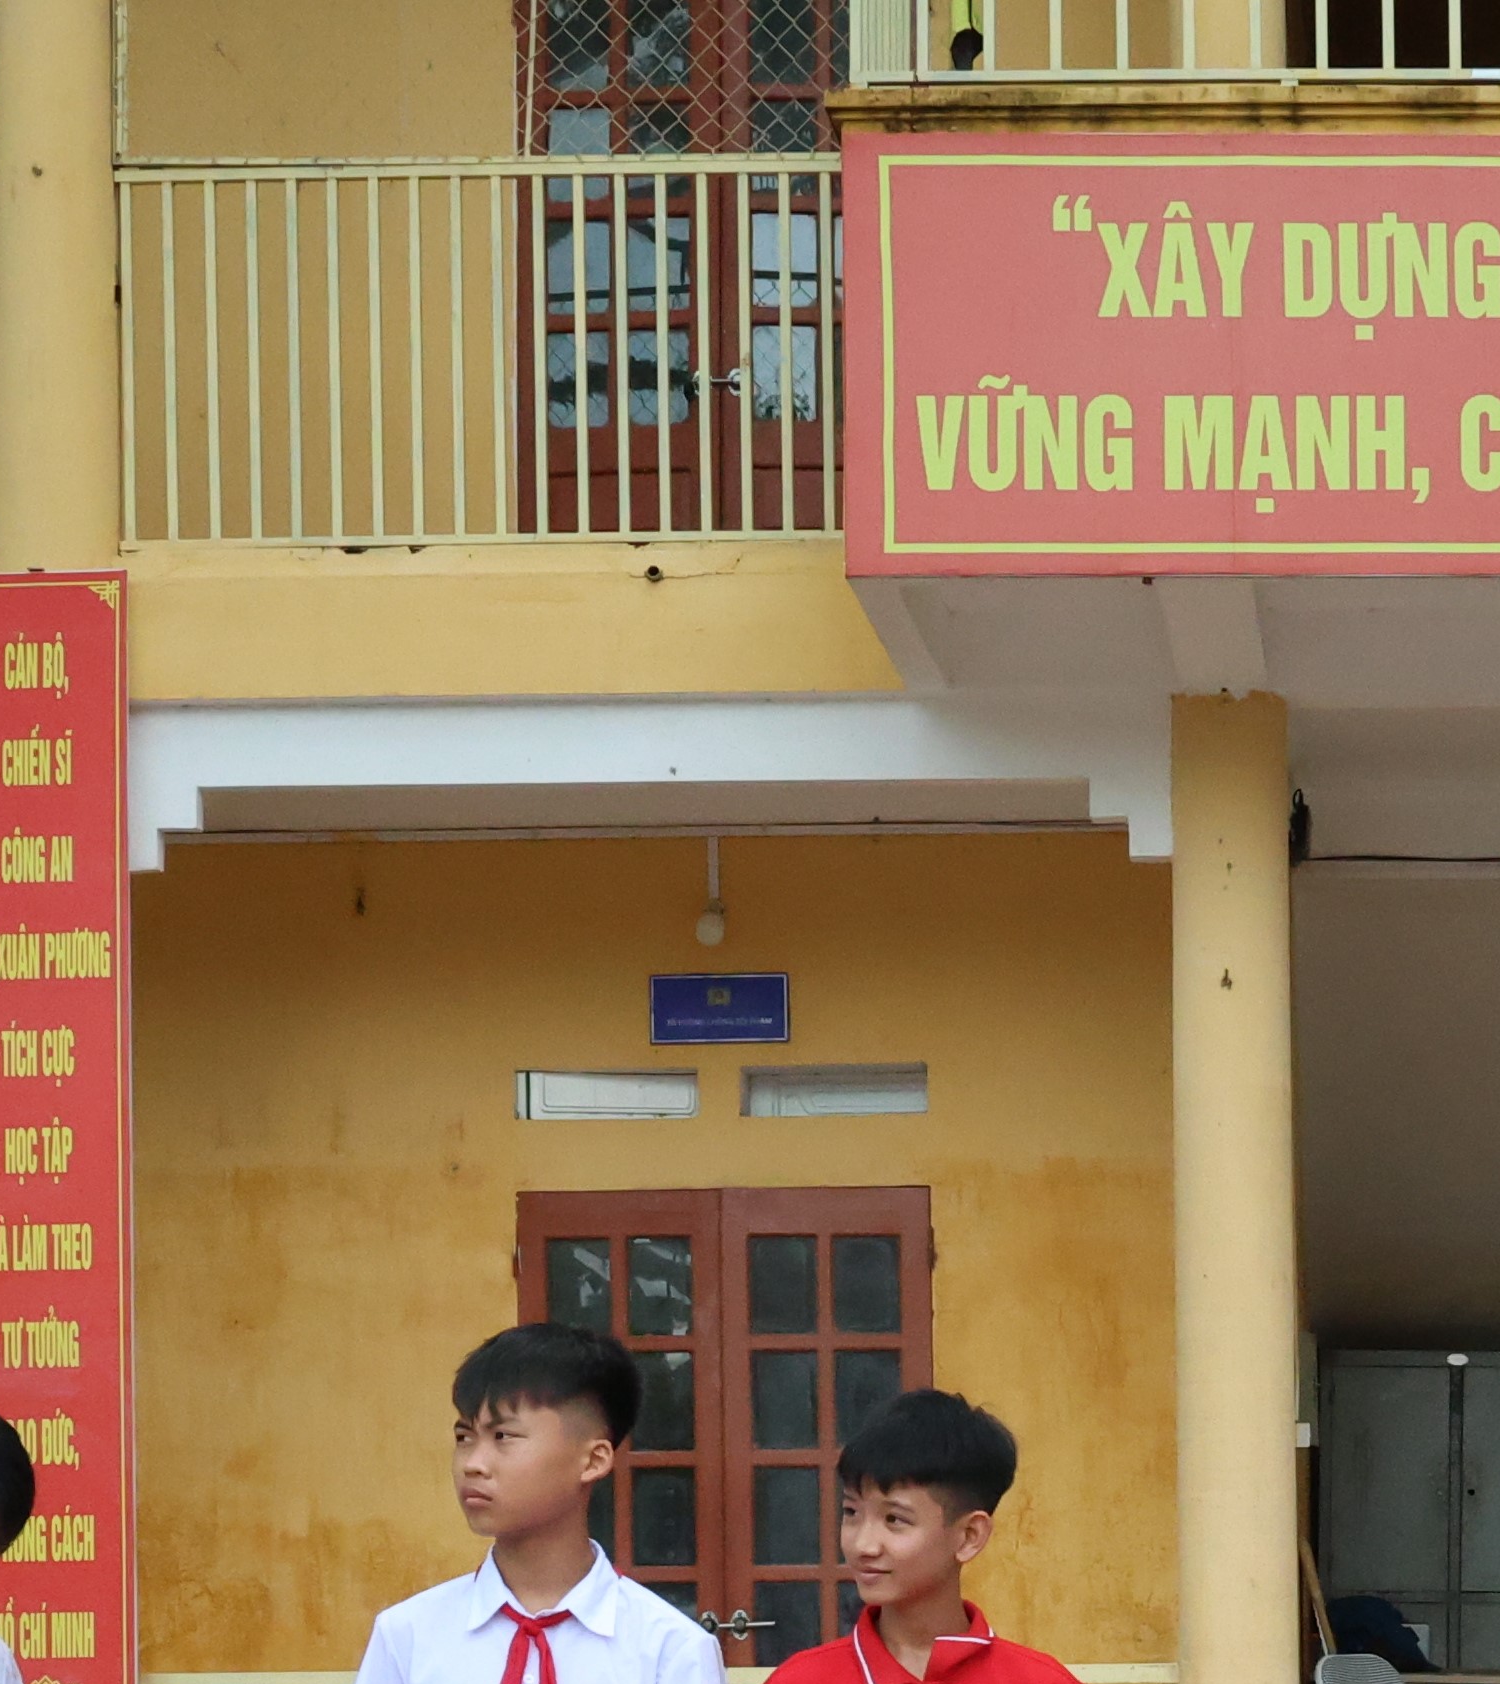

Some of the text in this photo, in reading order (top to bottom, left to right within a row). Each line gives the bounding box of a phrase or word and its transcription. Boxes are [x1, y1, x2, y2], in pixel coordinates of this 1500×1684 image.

[915, 374, 1133, 495] VỮNG
[1161, 396, 1434, 512] MẠNH,
[4, 632, 69, 699] CÁN BỘ,
[2, 723, 73, 787] CHIẾN SĨ
[1, 826, 73, 884] CÔNG AN
[44, 929, 111, 979] PHƯƠNG
[1, 1021, 75, 1087] TÍCH CỰC
[4, 1116, 74, 1185] HỌC TẬP
[12, 1214, 49, 1271] LÀM
[53, 1223, 92, 1271] THEO
[1, 1306, 80, 1369] TƯ TƯỞNG
[41, 1408, 79, 1471] ĐỨC,
[51, 1505, 95, 1562] CÁCH
[19, 1602, 47, 1659] CHÍ
[51, 1611, 95, 1658] MINH
